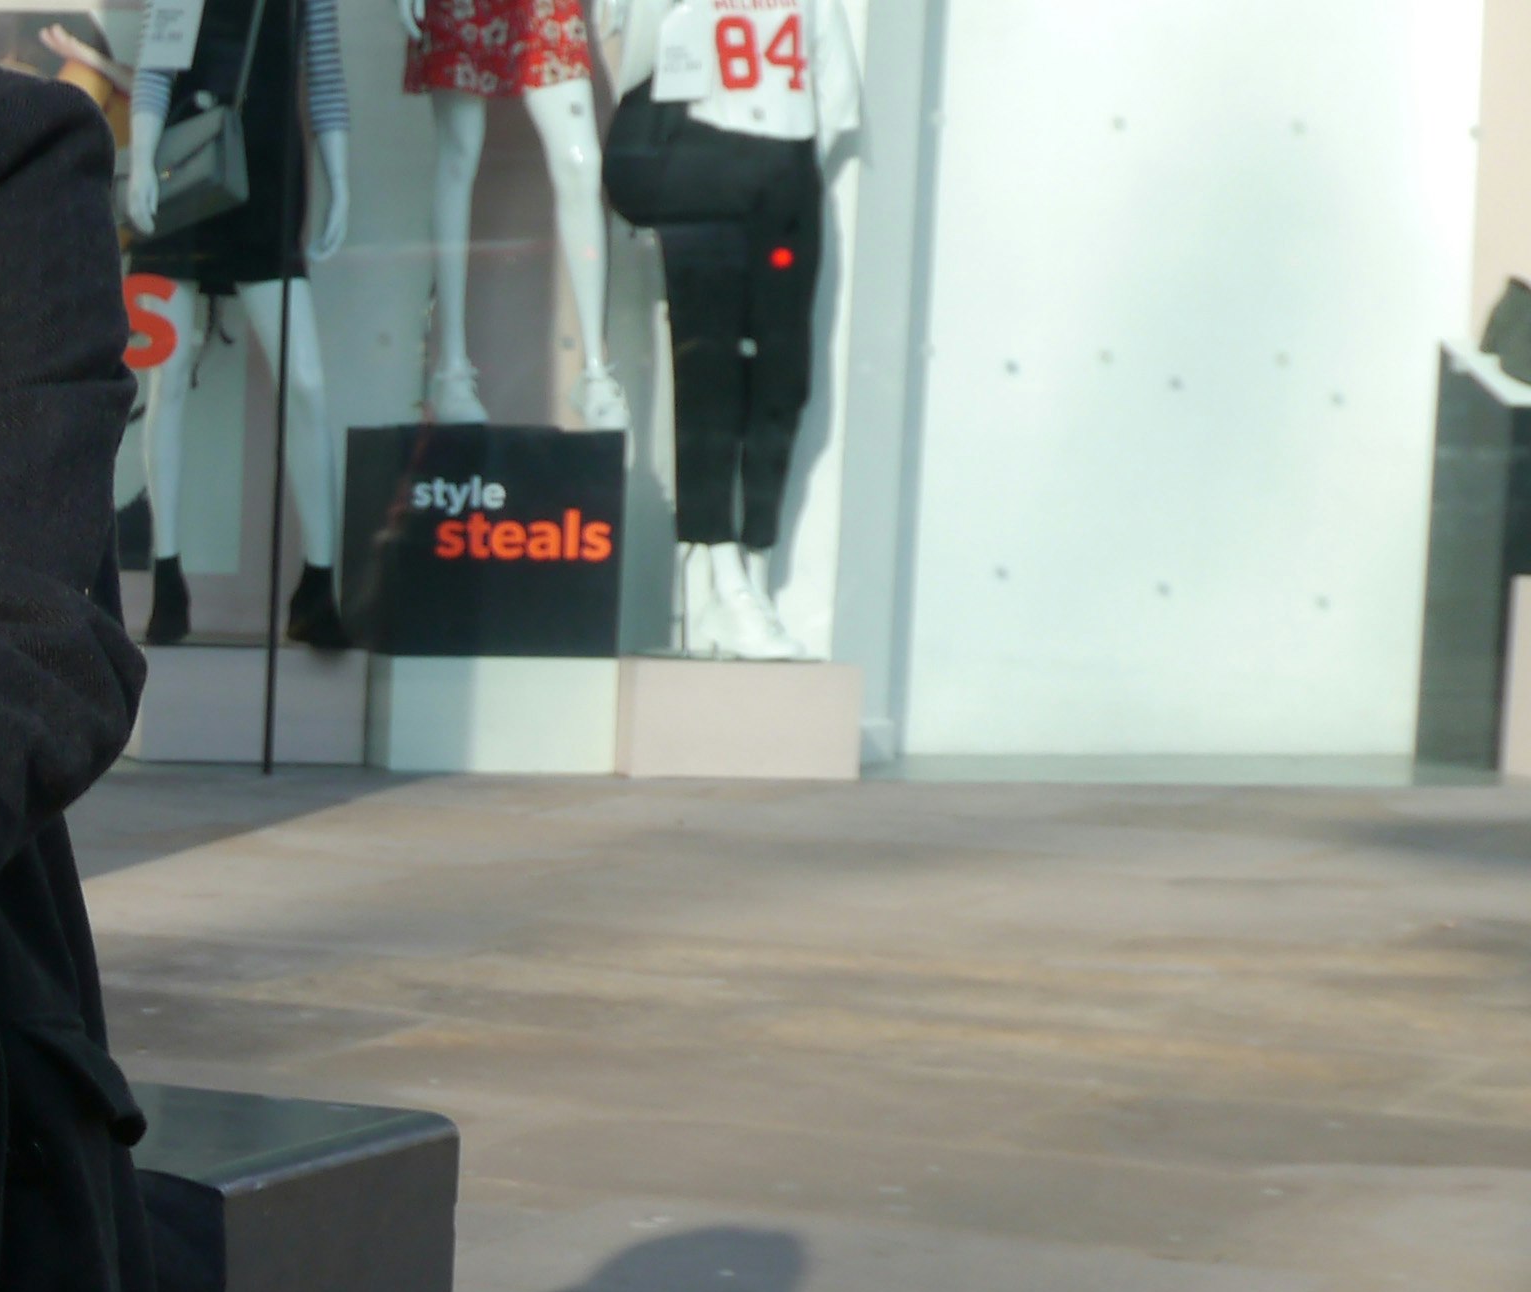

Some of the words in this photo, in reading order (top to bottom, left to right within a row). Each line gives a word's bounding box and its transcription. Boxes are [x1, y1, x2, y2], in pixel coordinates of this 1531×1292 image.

[715, 14, 807, 91] 84
[413, 477, 506, 513] style
[435, 508, 612, 563] steals
